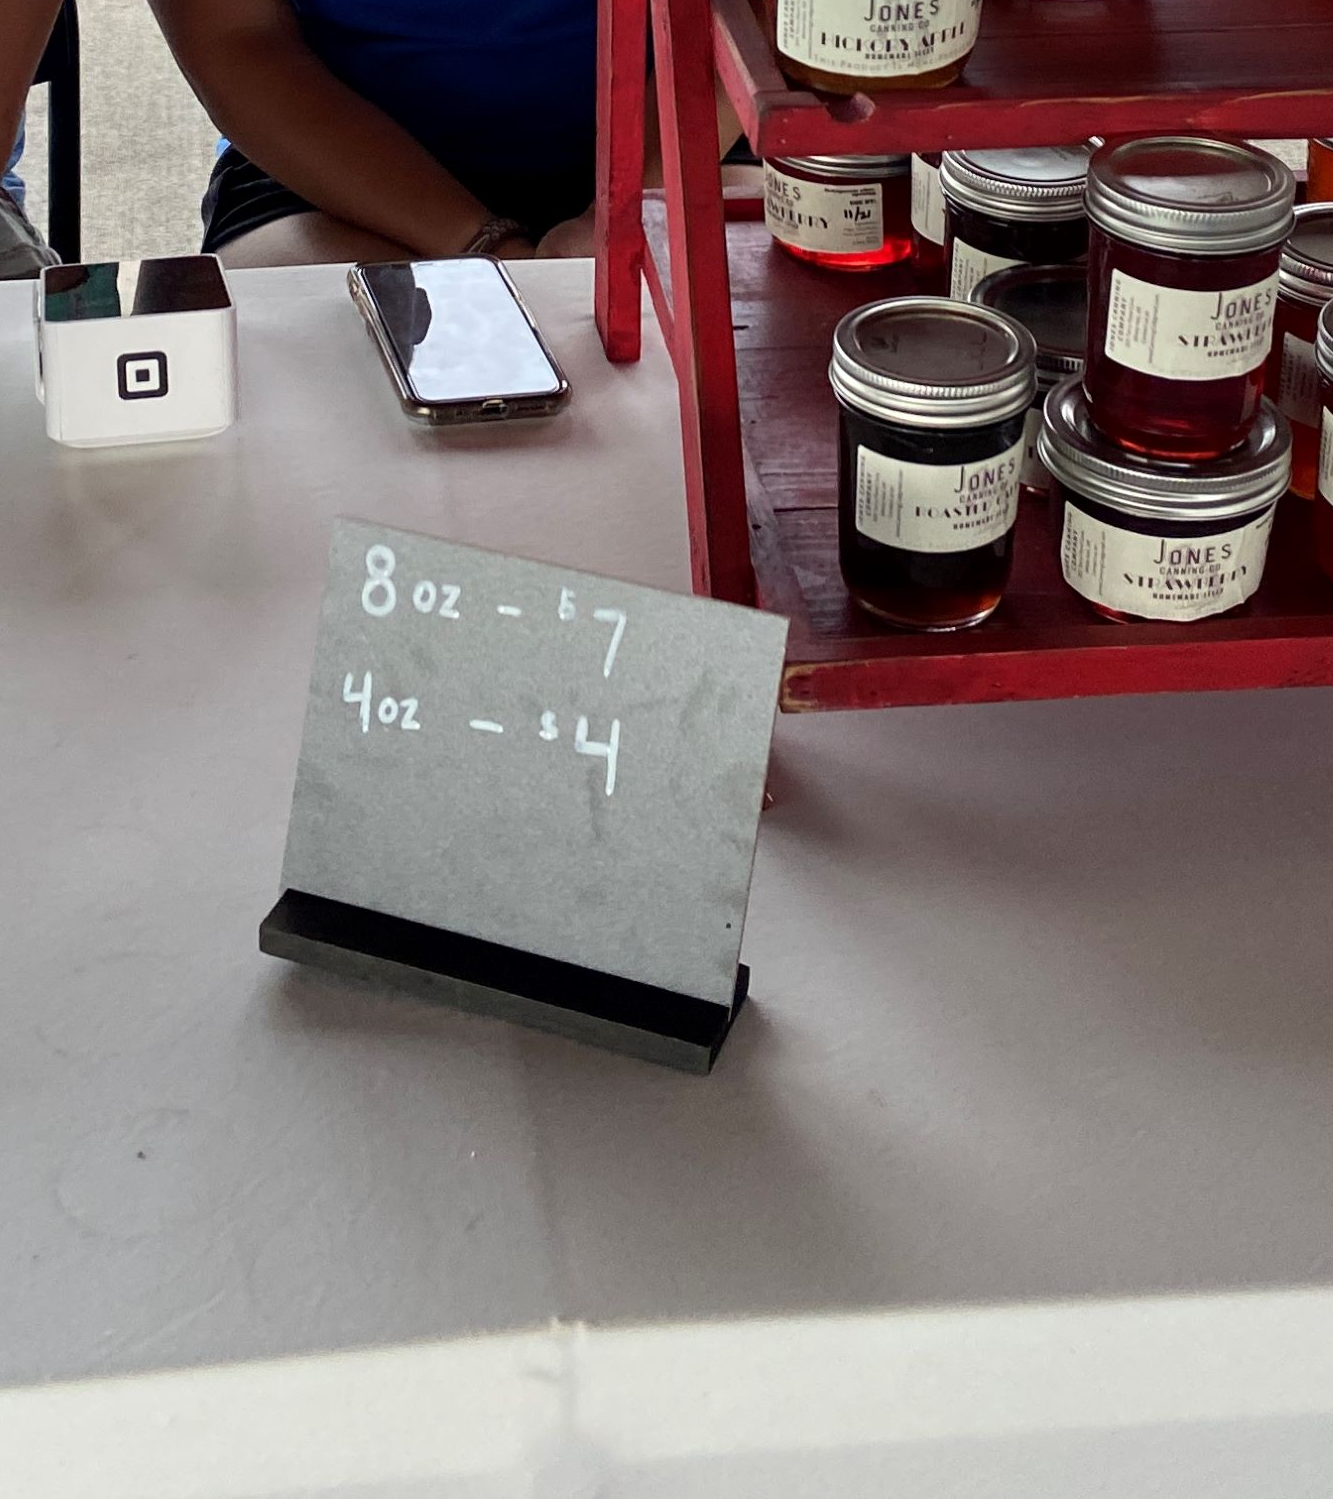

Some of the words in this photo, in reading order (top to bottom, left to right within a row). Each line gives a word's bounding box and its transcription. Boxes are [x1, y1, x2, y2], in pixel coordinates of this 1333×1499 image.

[821, 32, 910, 52] HICKORY
[916, 21, 966, 47] APPLE
[1210, 288, 1273, 321] JONES
[953, 457, 1016, 493] JONES
[1153, 539, 1233, 566] JONES
[1123, 566, 1248, 591] STRAWBERRY
